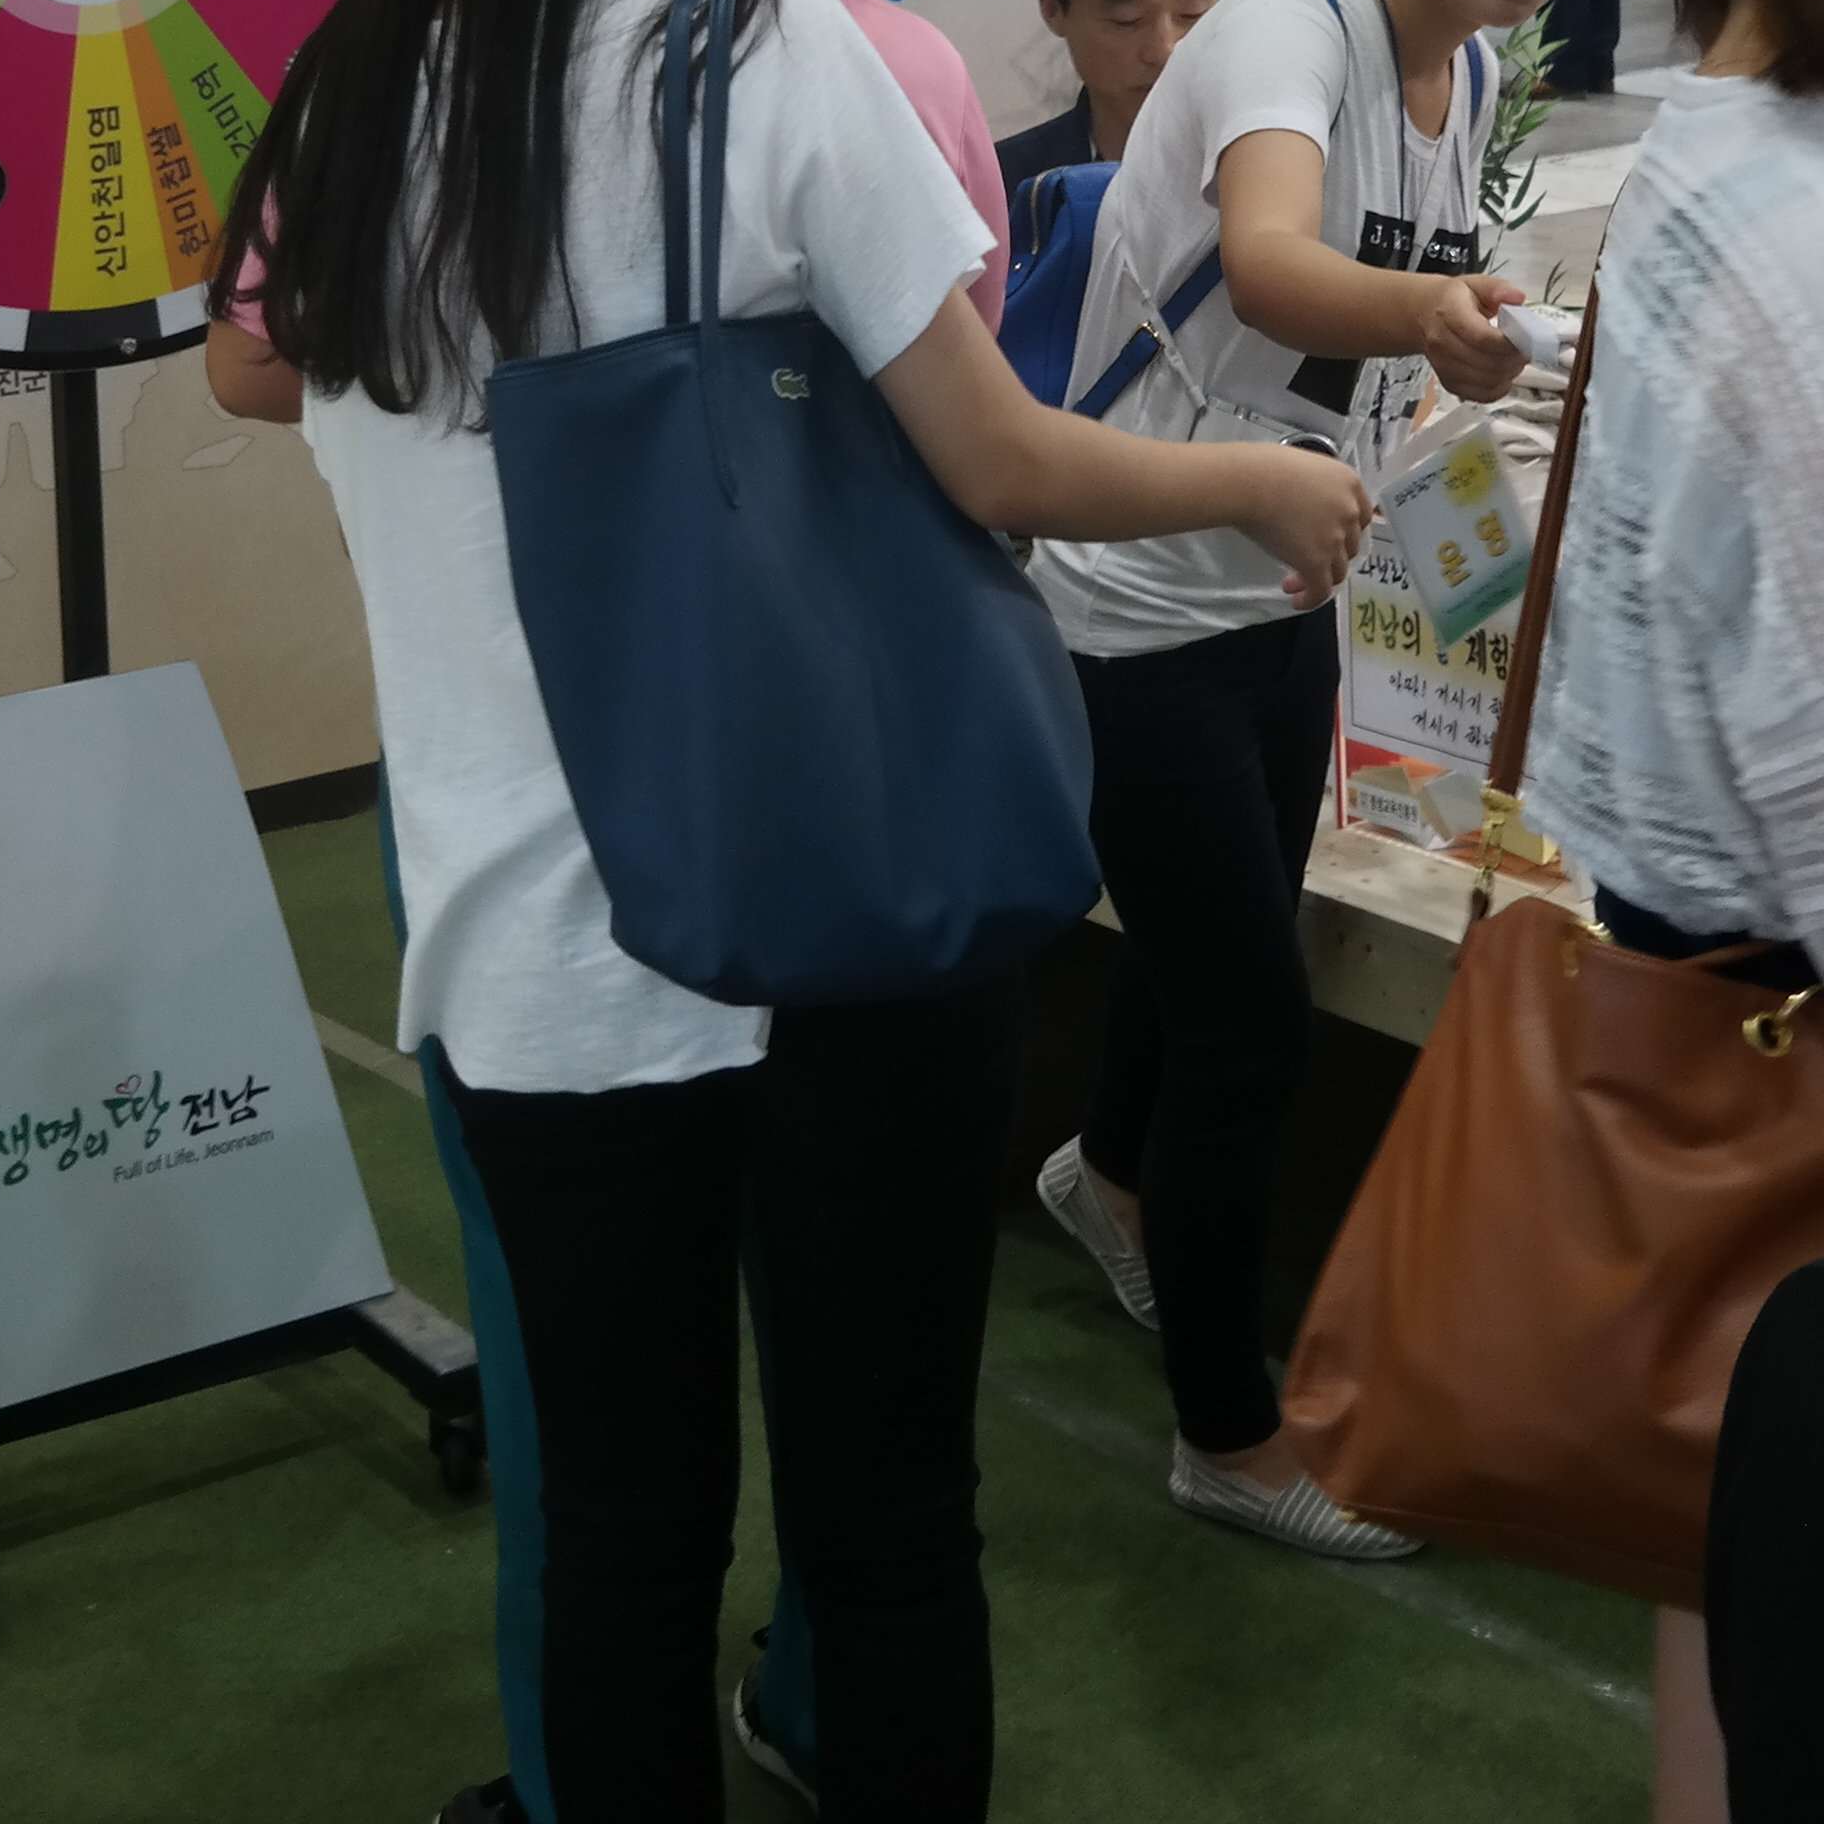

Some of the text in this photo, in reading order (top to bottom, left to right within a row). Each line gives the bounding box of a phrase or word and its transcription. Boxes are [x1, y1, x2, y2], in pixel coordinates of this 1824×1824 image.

[190, 62, 263, 160] 건미역
[86, 104, 126, 278] 신안천일염
[146, 120, 211, 258] 현미찹쌀
[102, 1069, 171, 1150] 땅
[178, 1074, 272, 1137] 전남
[113, 1127, 275, 1184] Full of Life, Jeonnam
